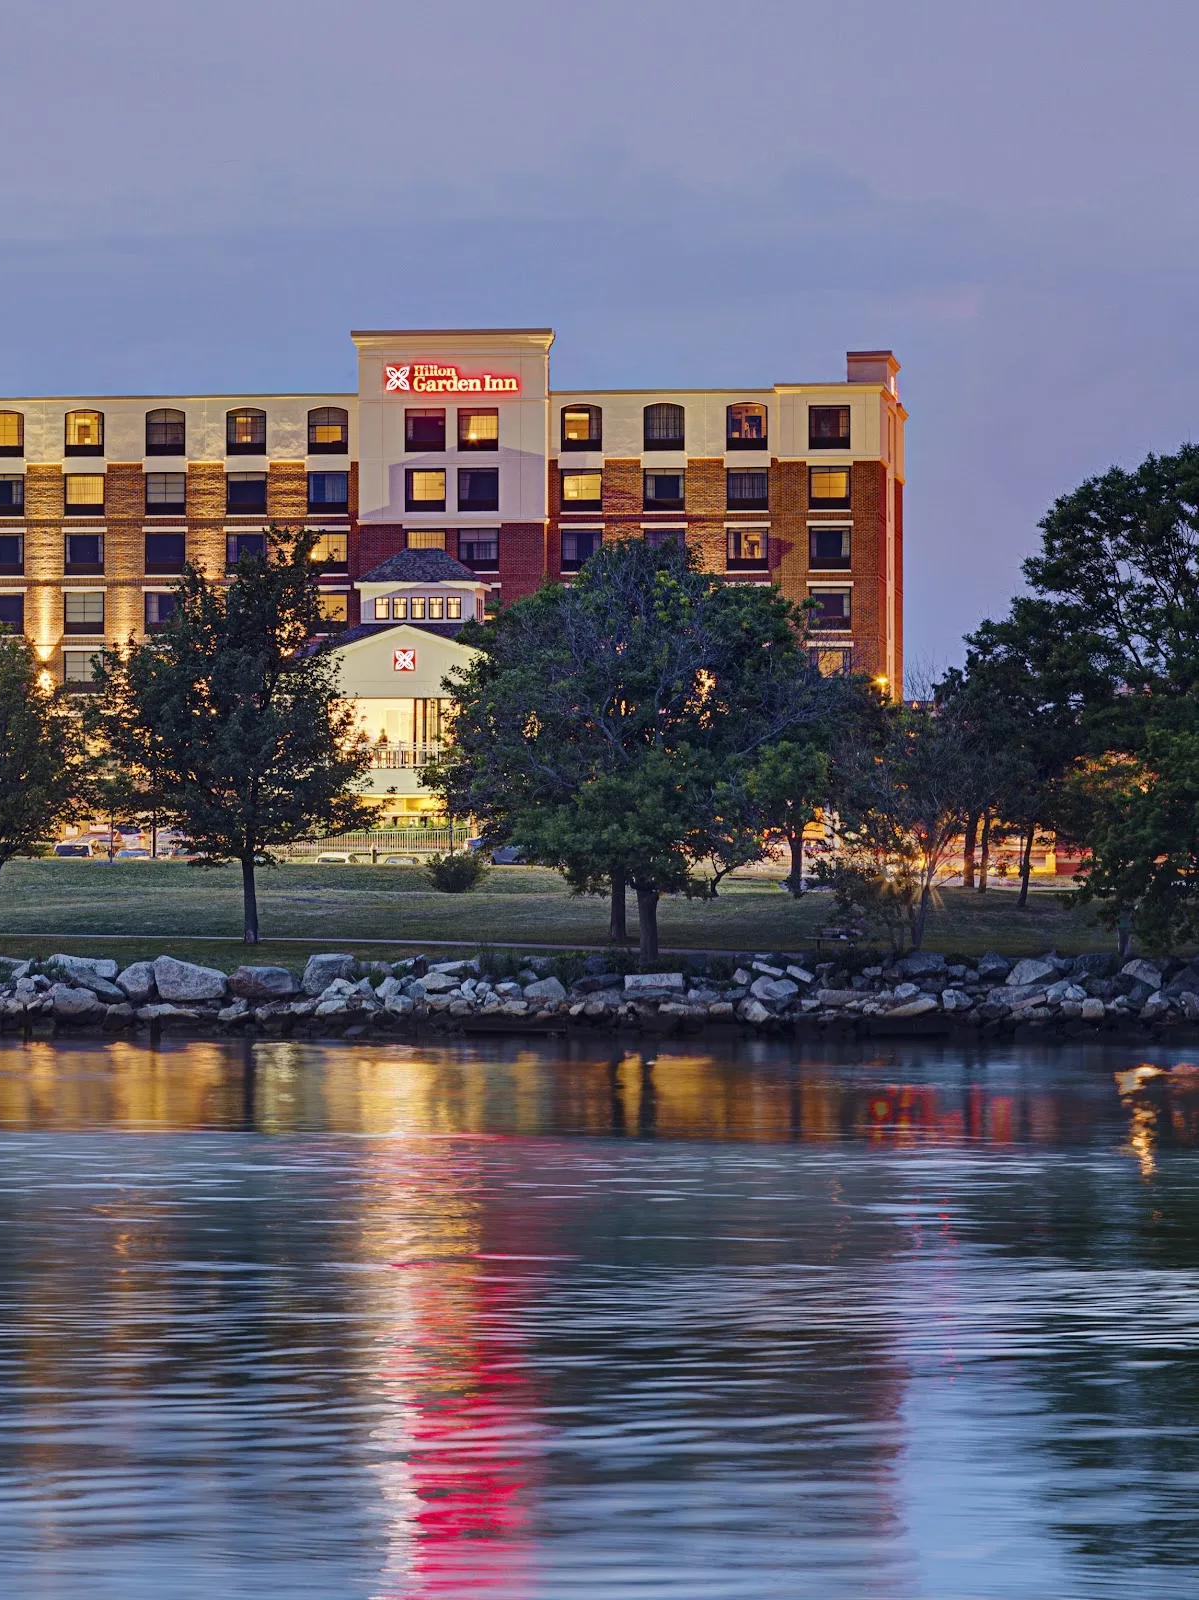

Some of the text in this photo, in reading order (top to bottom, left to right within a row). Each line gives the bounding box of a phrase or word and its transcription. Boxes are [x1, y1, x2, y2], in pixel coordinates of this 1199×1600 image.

[413, 365, 456, 377] Hilton
[413, 375, 518, 392] Garden Inn
